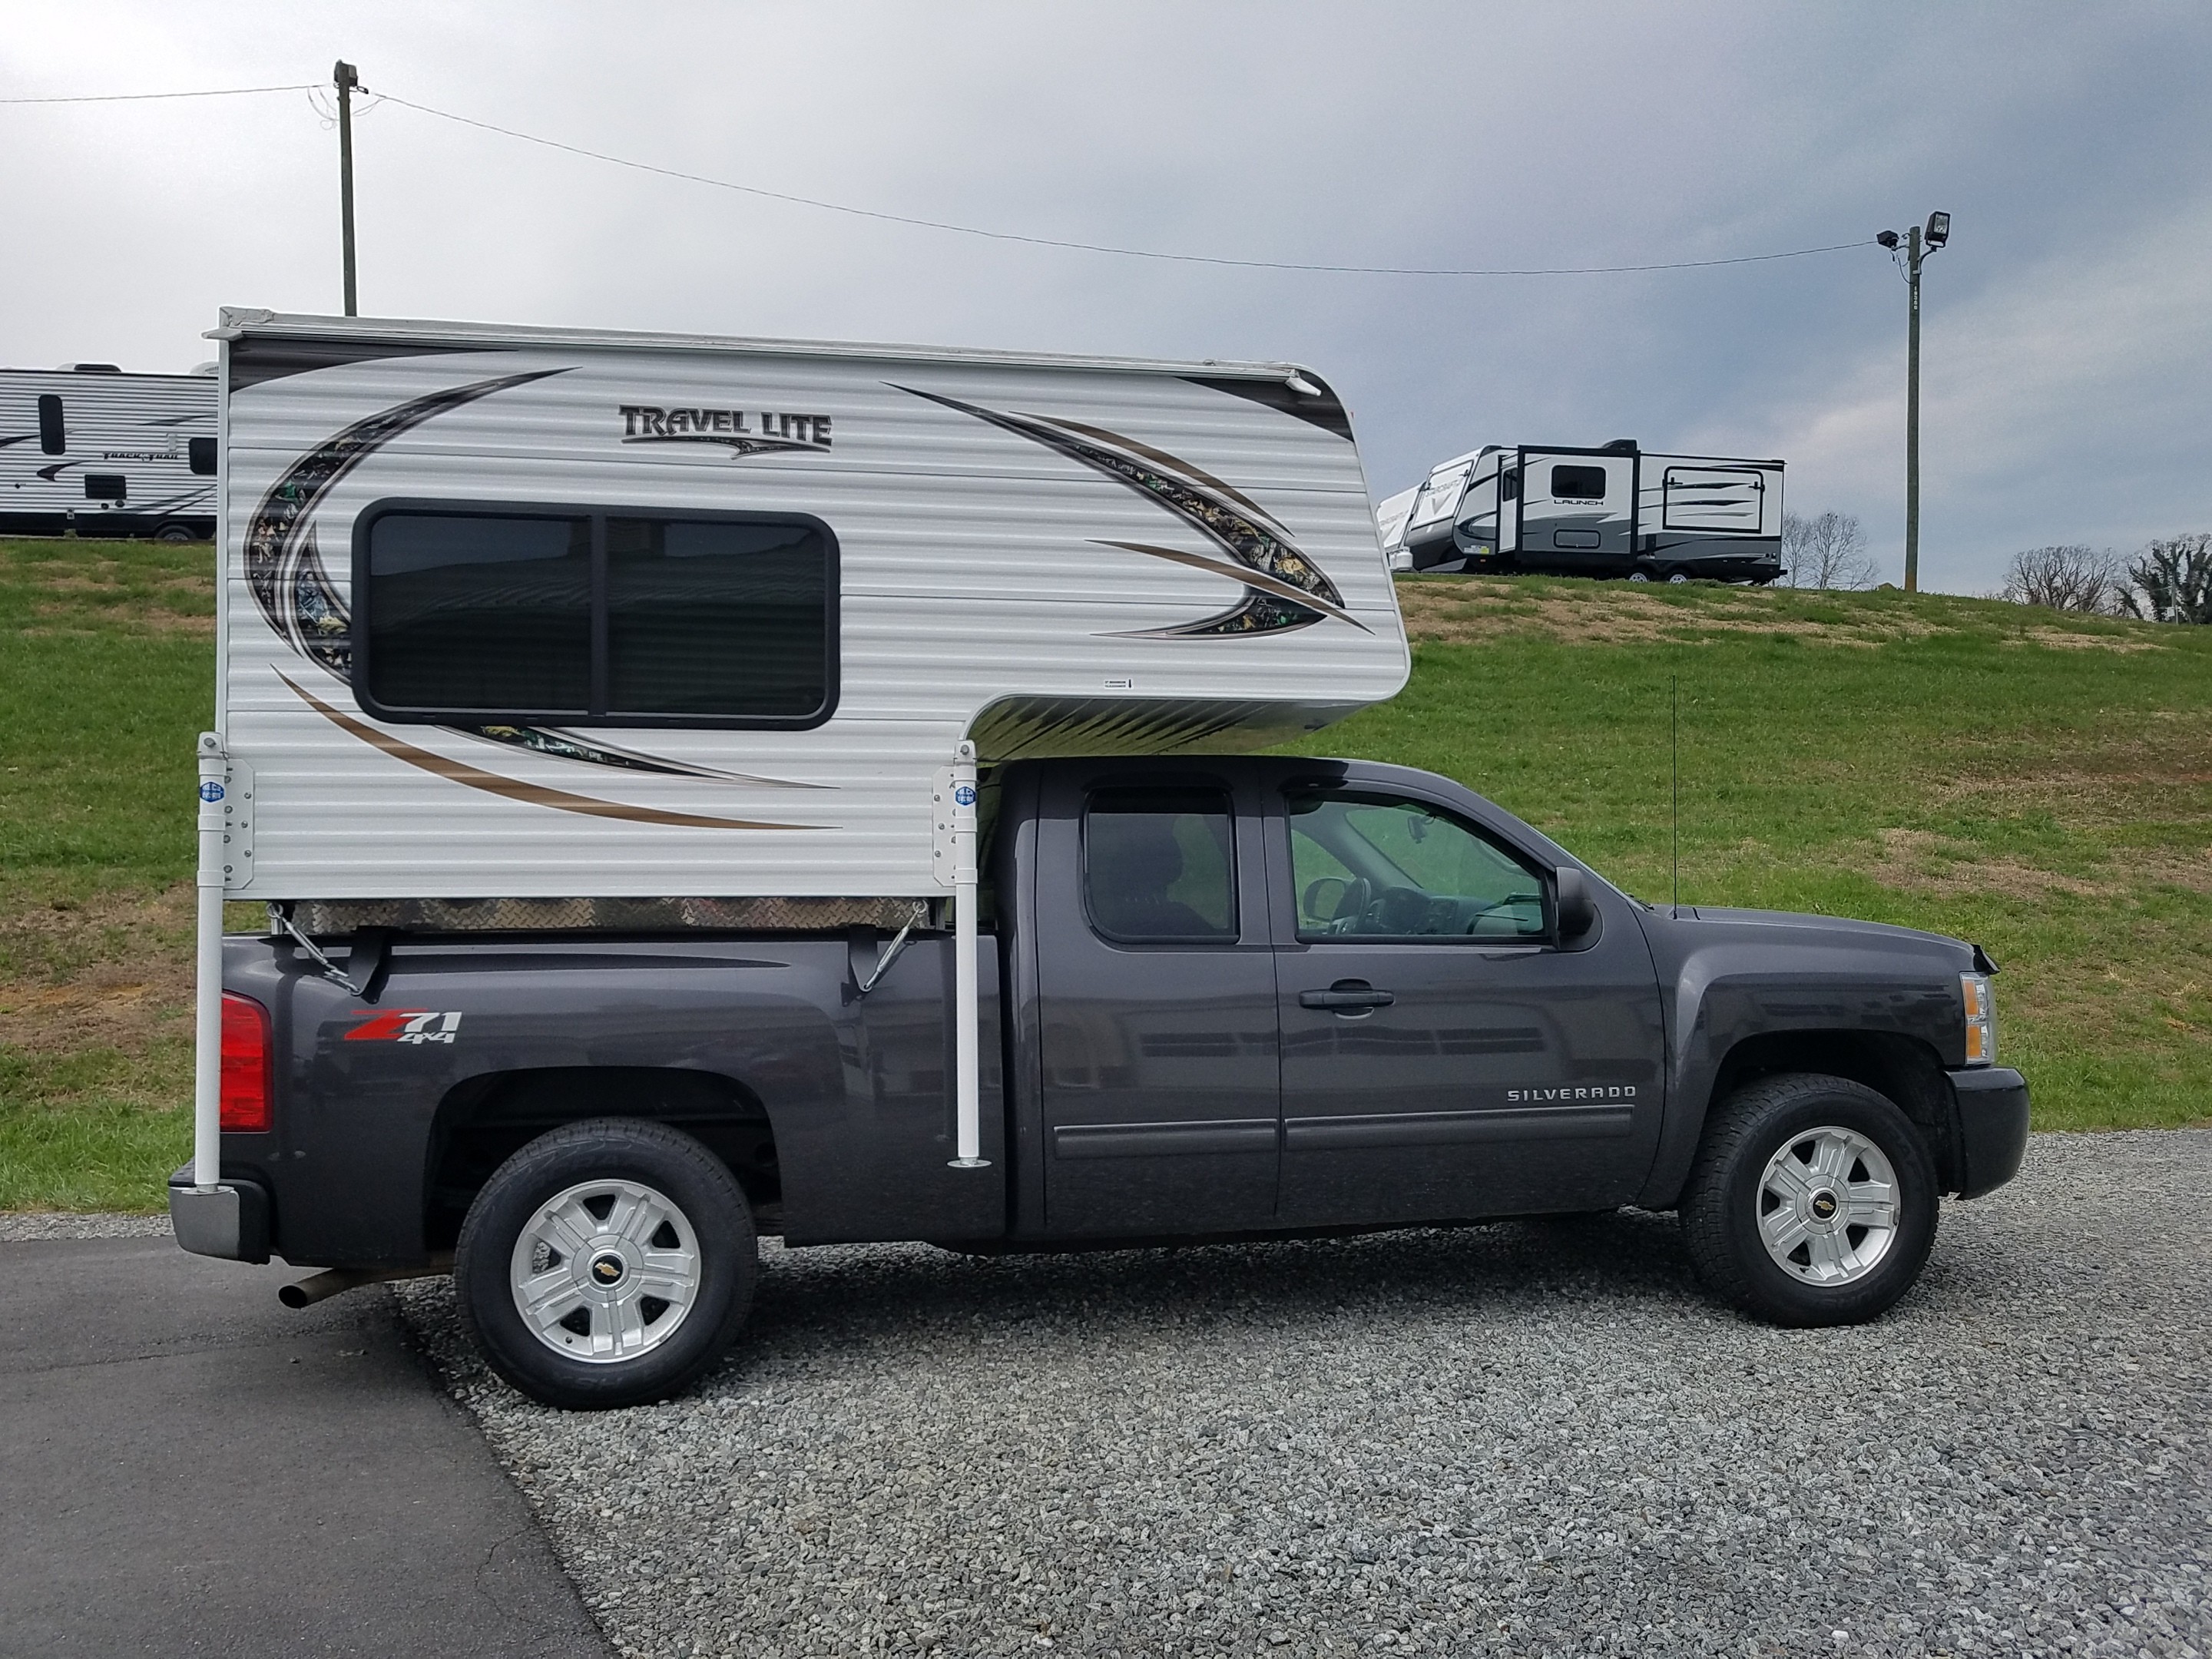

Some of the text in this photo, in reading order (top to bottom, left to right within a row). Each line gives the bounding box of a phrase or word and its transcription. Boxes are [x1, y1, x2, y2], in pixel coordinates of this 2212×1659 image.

[619, 404, 833, 446] TRAVEL LITE
[344, 1007, 462, 1040] Z71
[1507, 1086, 1636, 1101] SILVERADO
